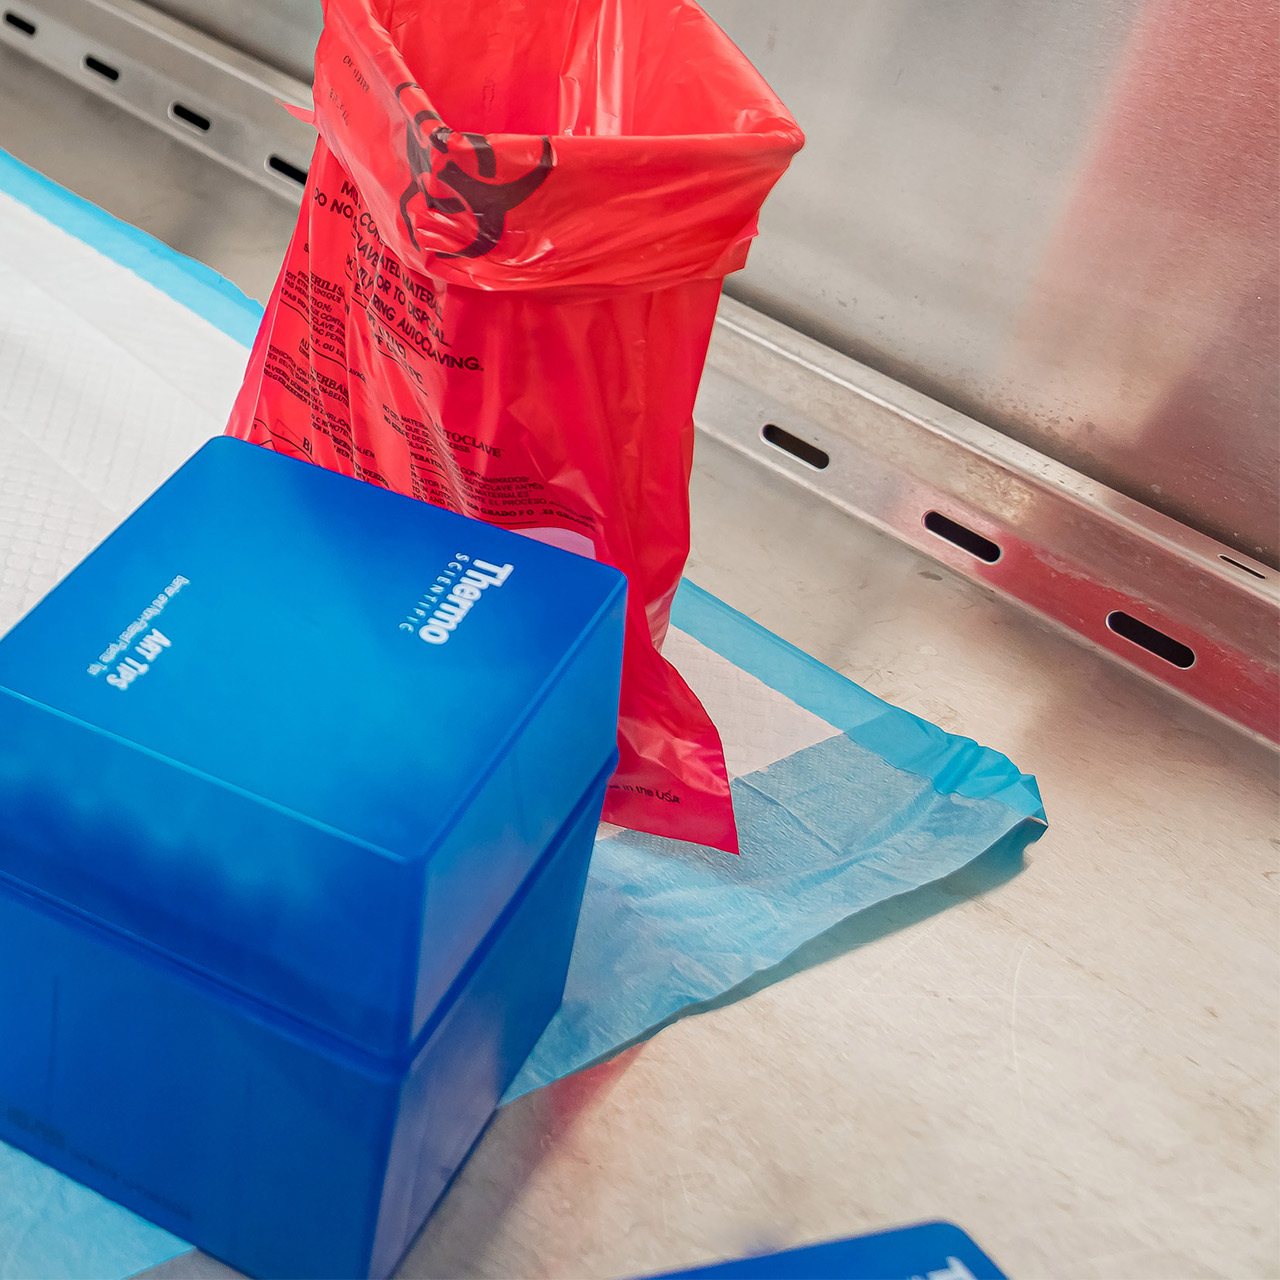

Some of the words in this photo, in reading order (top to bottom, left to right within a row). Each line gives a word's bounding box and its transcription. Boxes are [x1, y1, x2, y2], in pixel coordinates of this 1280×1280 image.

[394, 286, 406, 306] TO
[398, 552, 470, 634] SCIENTIFIC
[418, 558, 514, 645] Thermo
[134, 628, 172, 662] ART
[636, 785, 654, 797] the
[656, 790, 680, 804] USA
